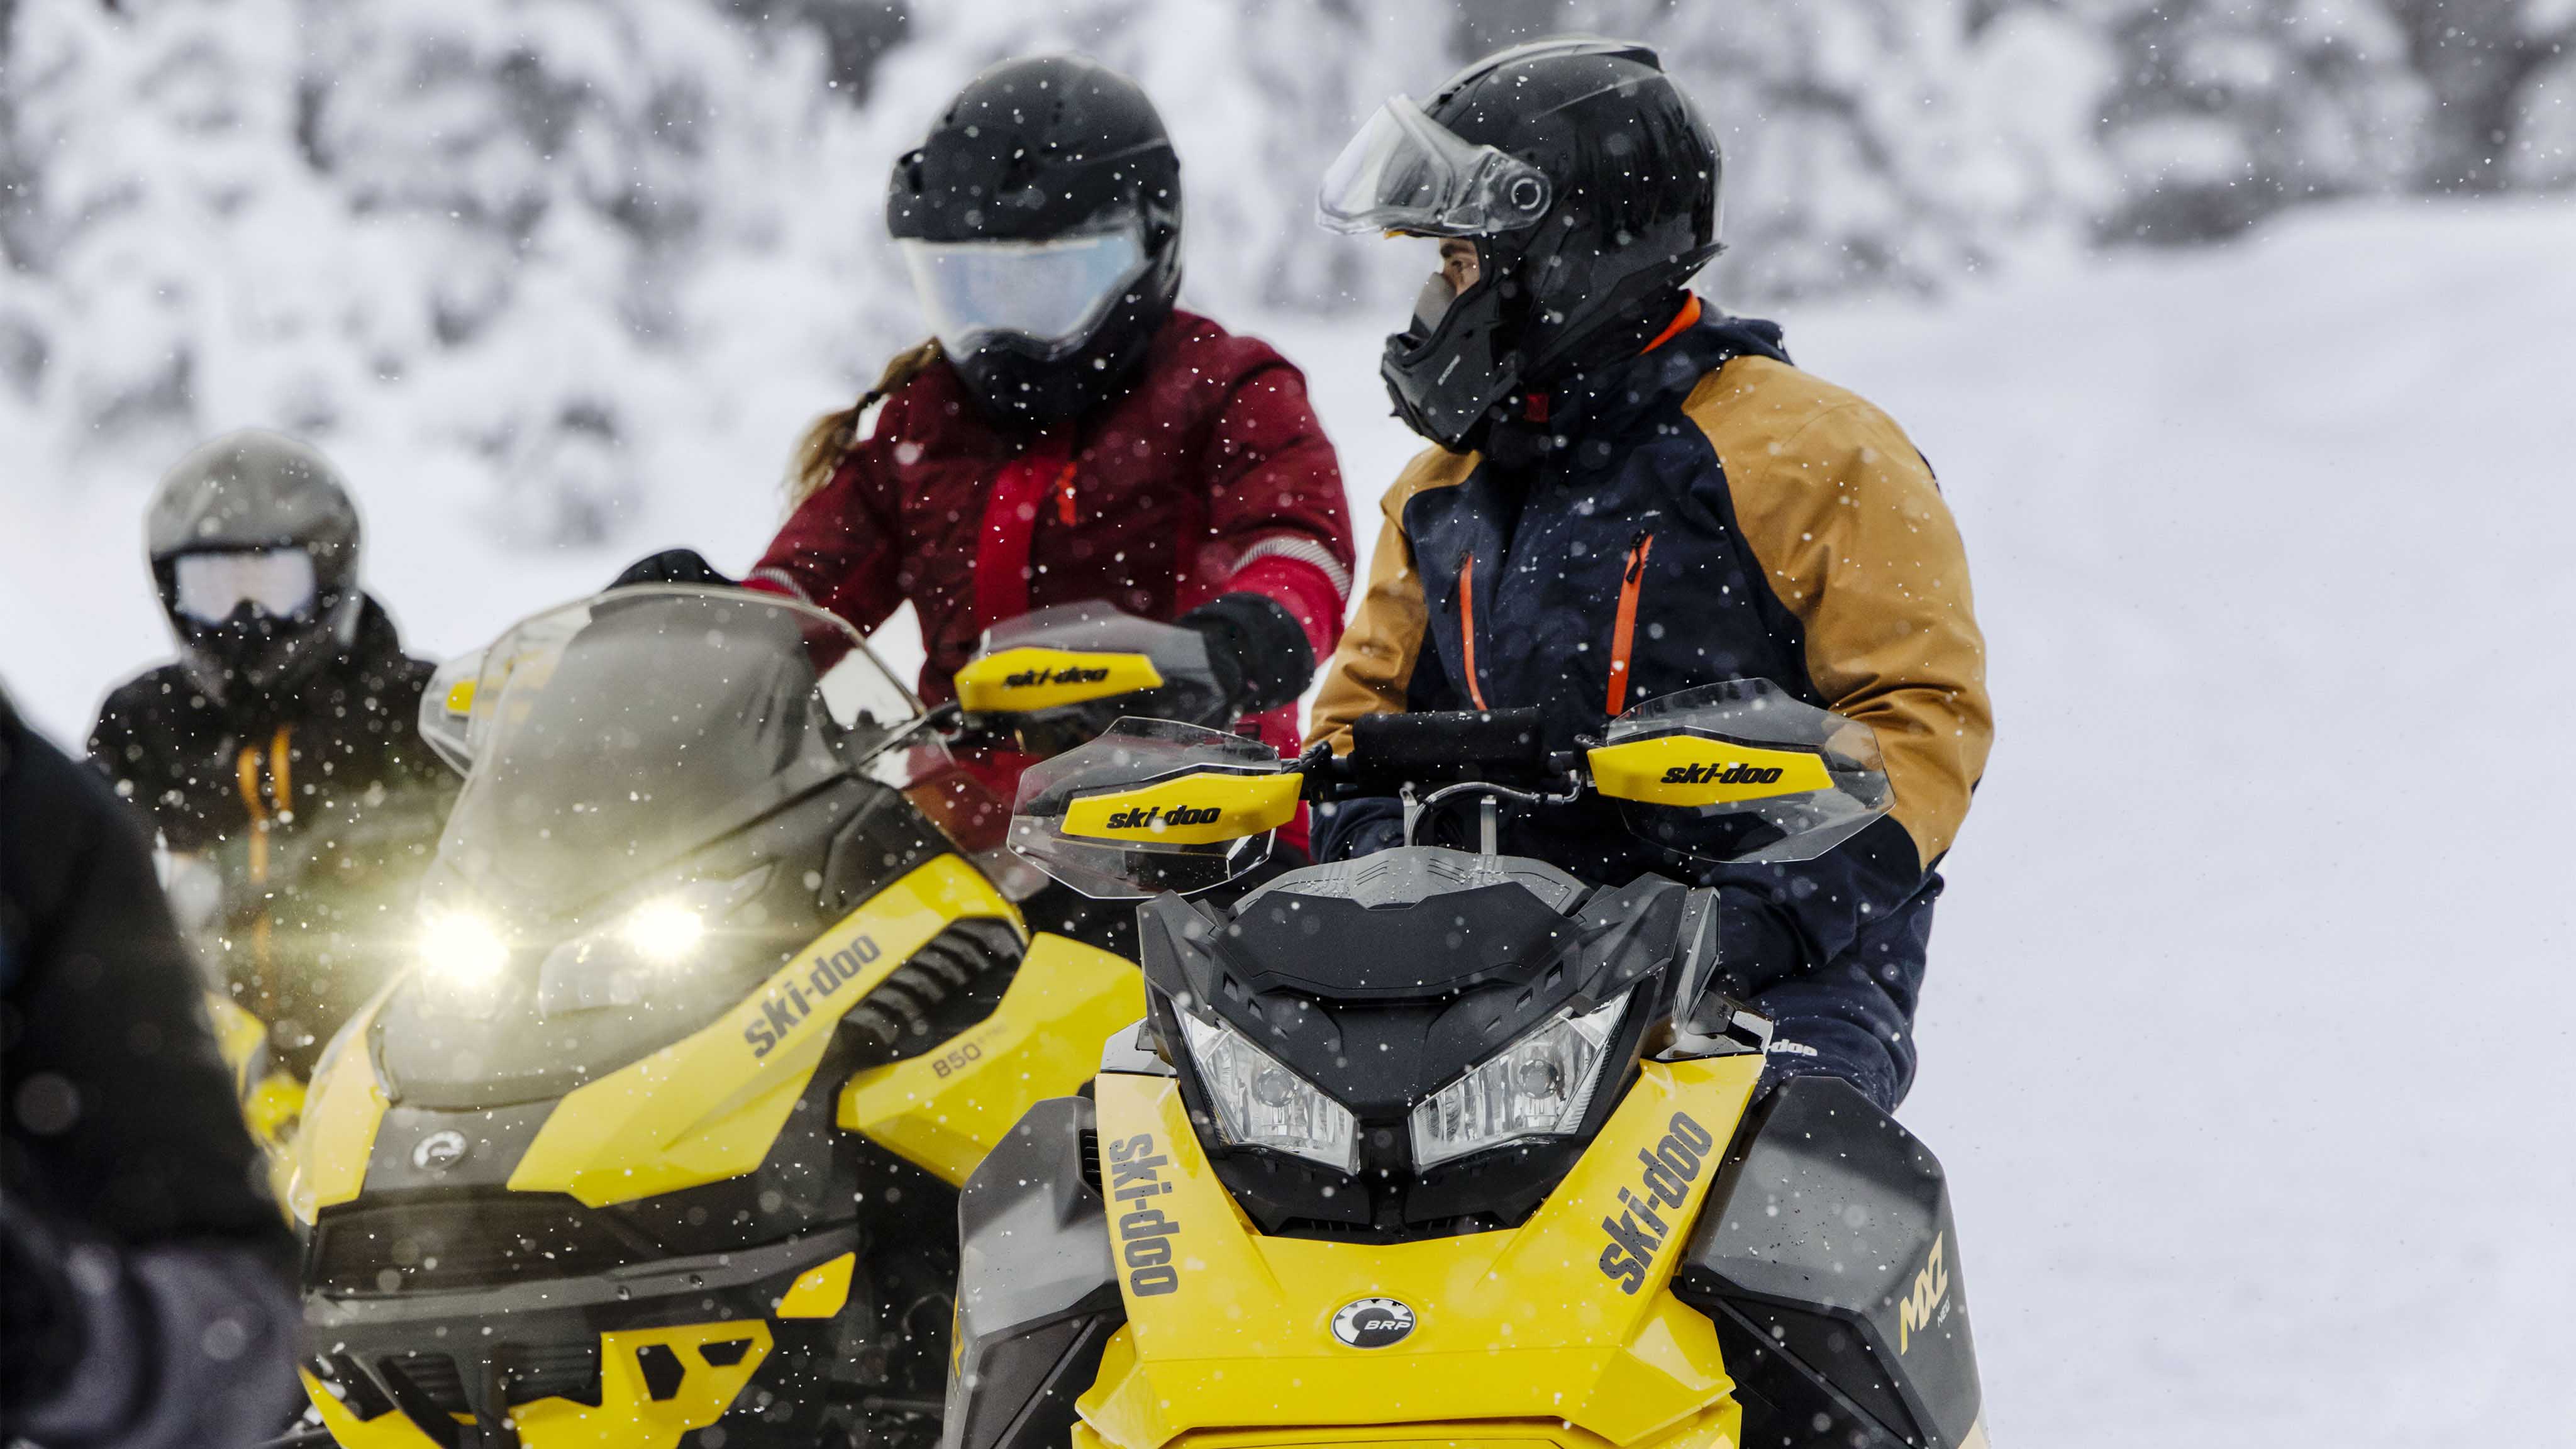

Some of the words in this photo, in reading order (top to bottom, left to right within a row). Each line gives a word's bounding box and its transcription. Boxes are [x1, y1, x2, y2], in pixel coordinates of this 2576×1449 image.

[1002, 666, 1109, 687] ski-doo
[1660, 763, 1784, 784] ski-doo
[1107, 805, 1221, 830] ski-doo
[745, 935, 881, 1058] ski-doo
[932, 1041, 982, 1078] 850
[1108, 1133, 1180, 1297] ski-doo
[1599, 1111, 1713, 1295] ski-doo
[1900, 1230, 1947, 1355] MXZ
[1363, 1320, 1411, 1330] BRP
